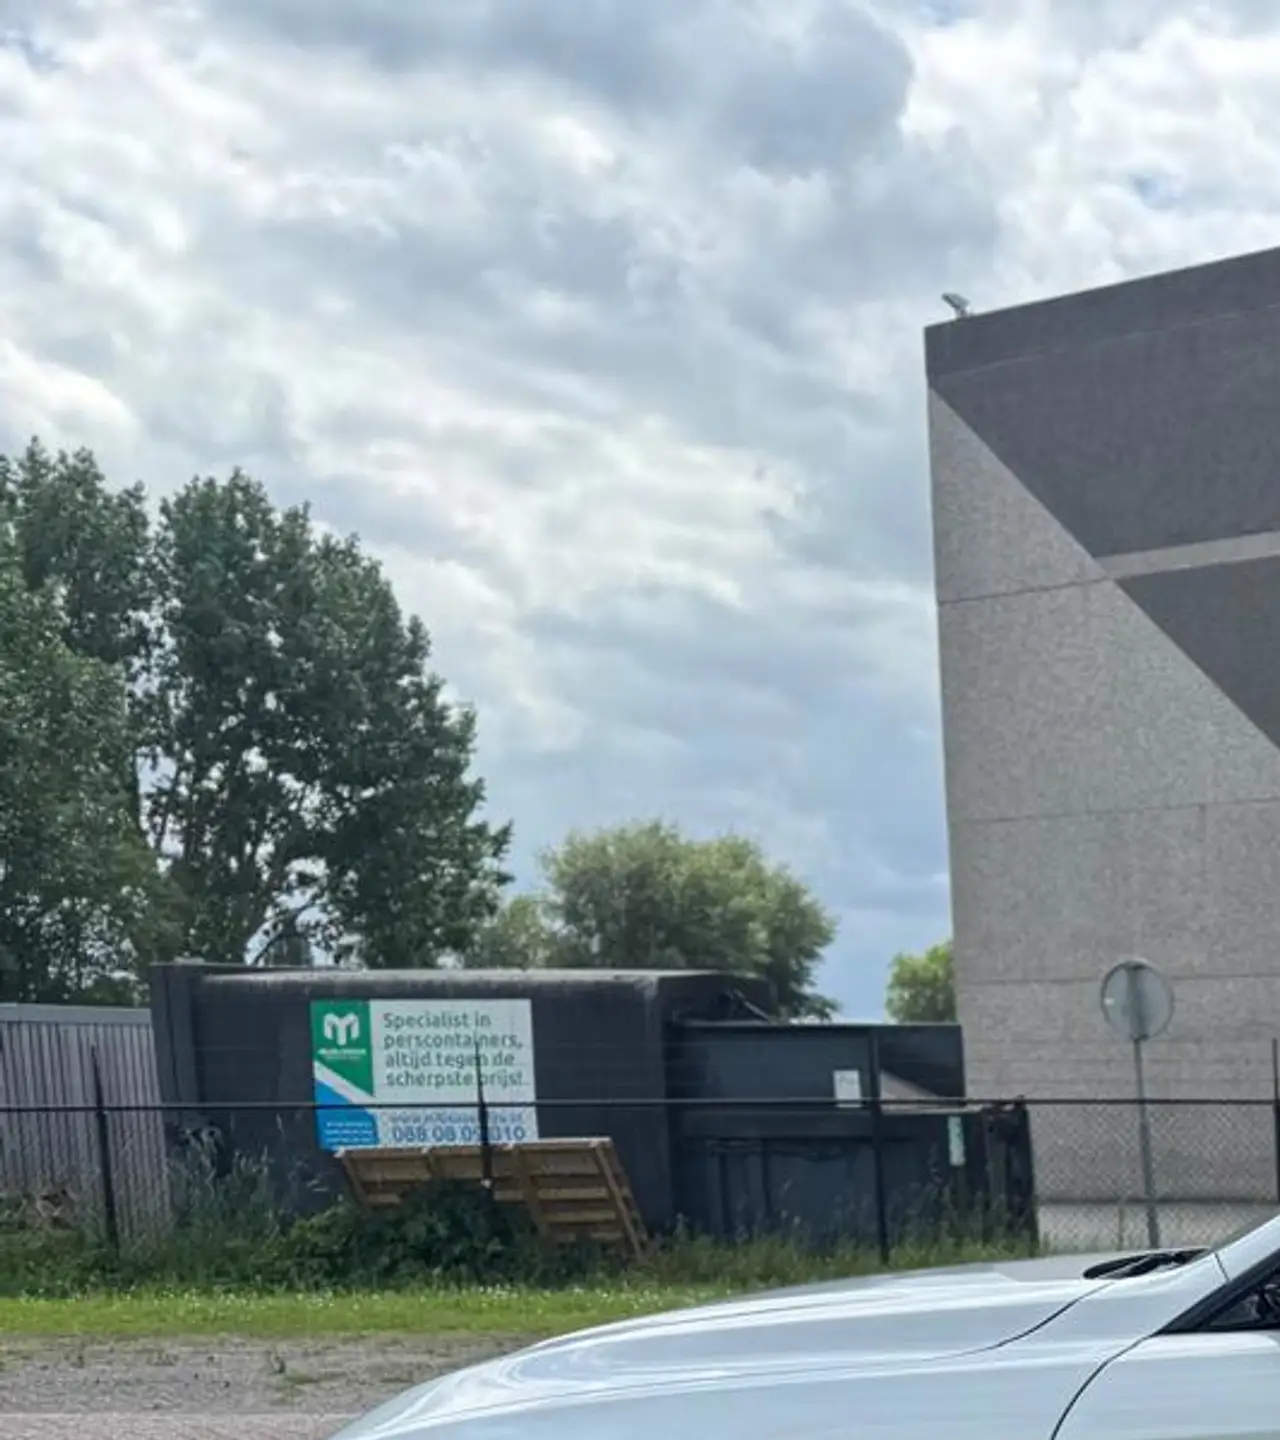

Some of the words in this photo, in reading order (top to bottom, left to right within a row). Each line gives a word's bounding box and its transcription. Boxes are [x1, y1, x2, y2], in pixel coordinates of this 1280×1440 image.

[383, 1011, 469, 1031] Specialist
[474, 1010, 492, 1027] in
[383, 1032, 524, 1050] perscontainers,
[385, 1051, 432, 1069] altijd
[436, 1052, 489, 1069] tegen
[493, 1051, 515, 1067] de
[386, 1070, 474, 1089] scherpste
